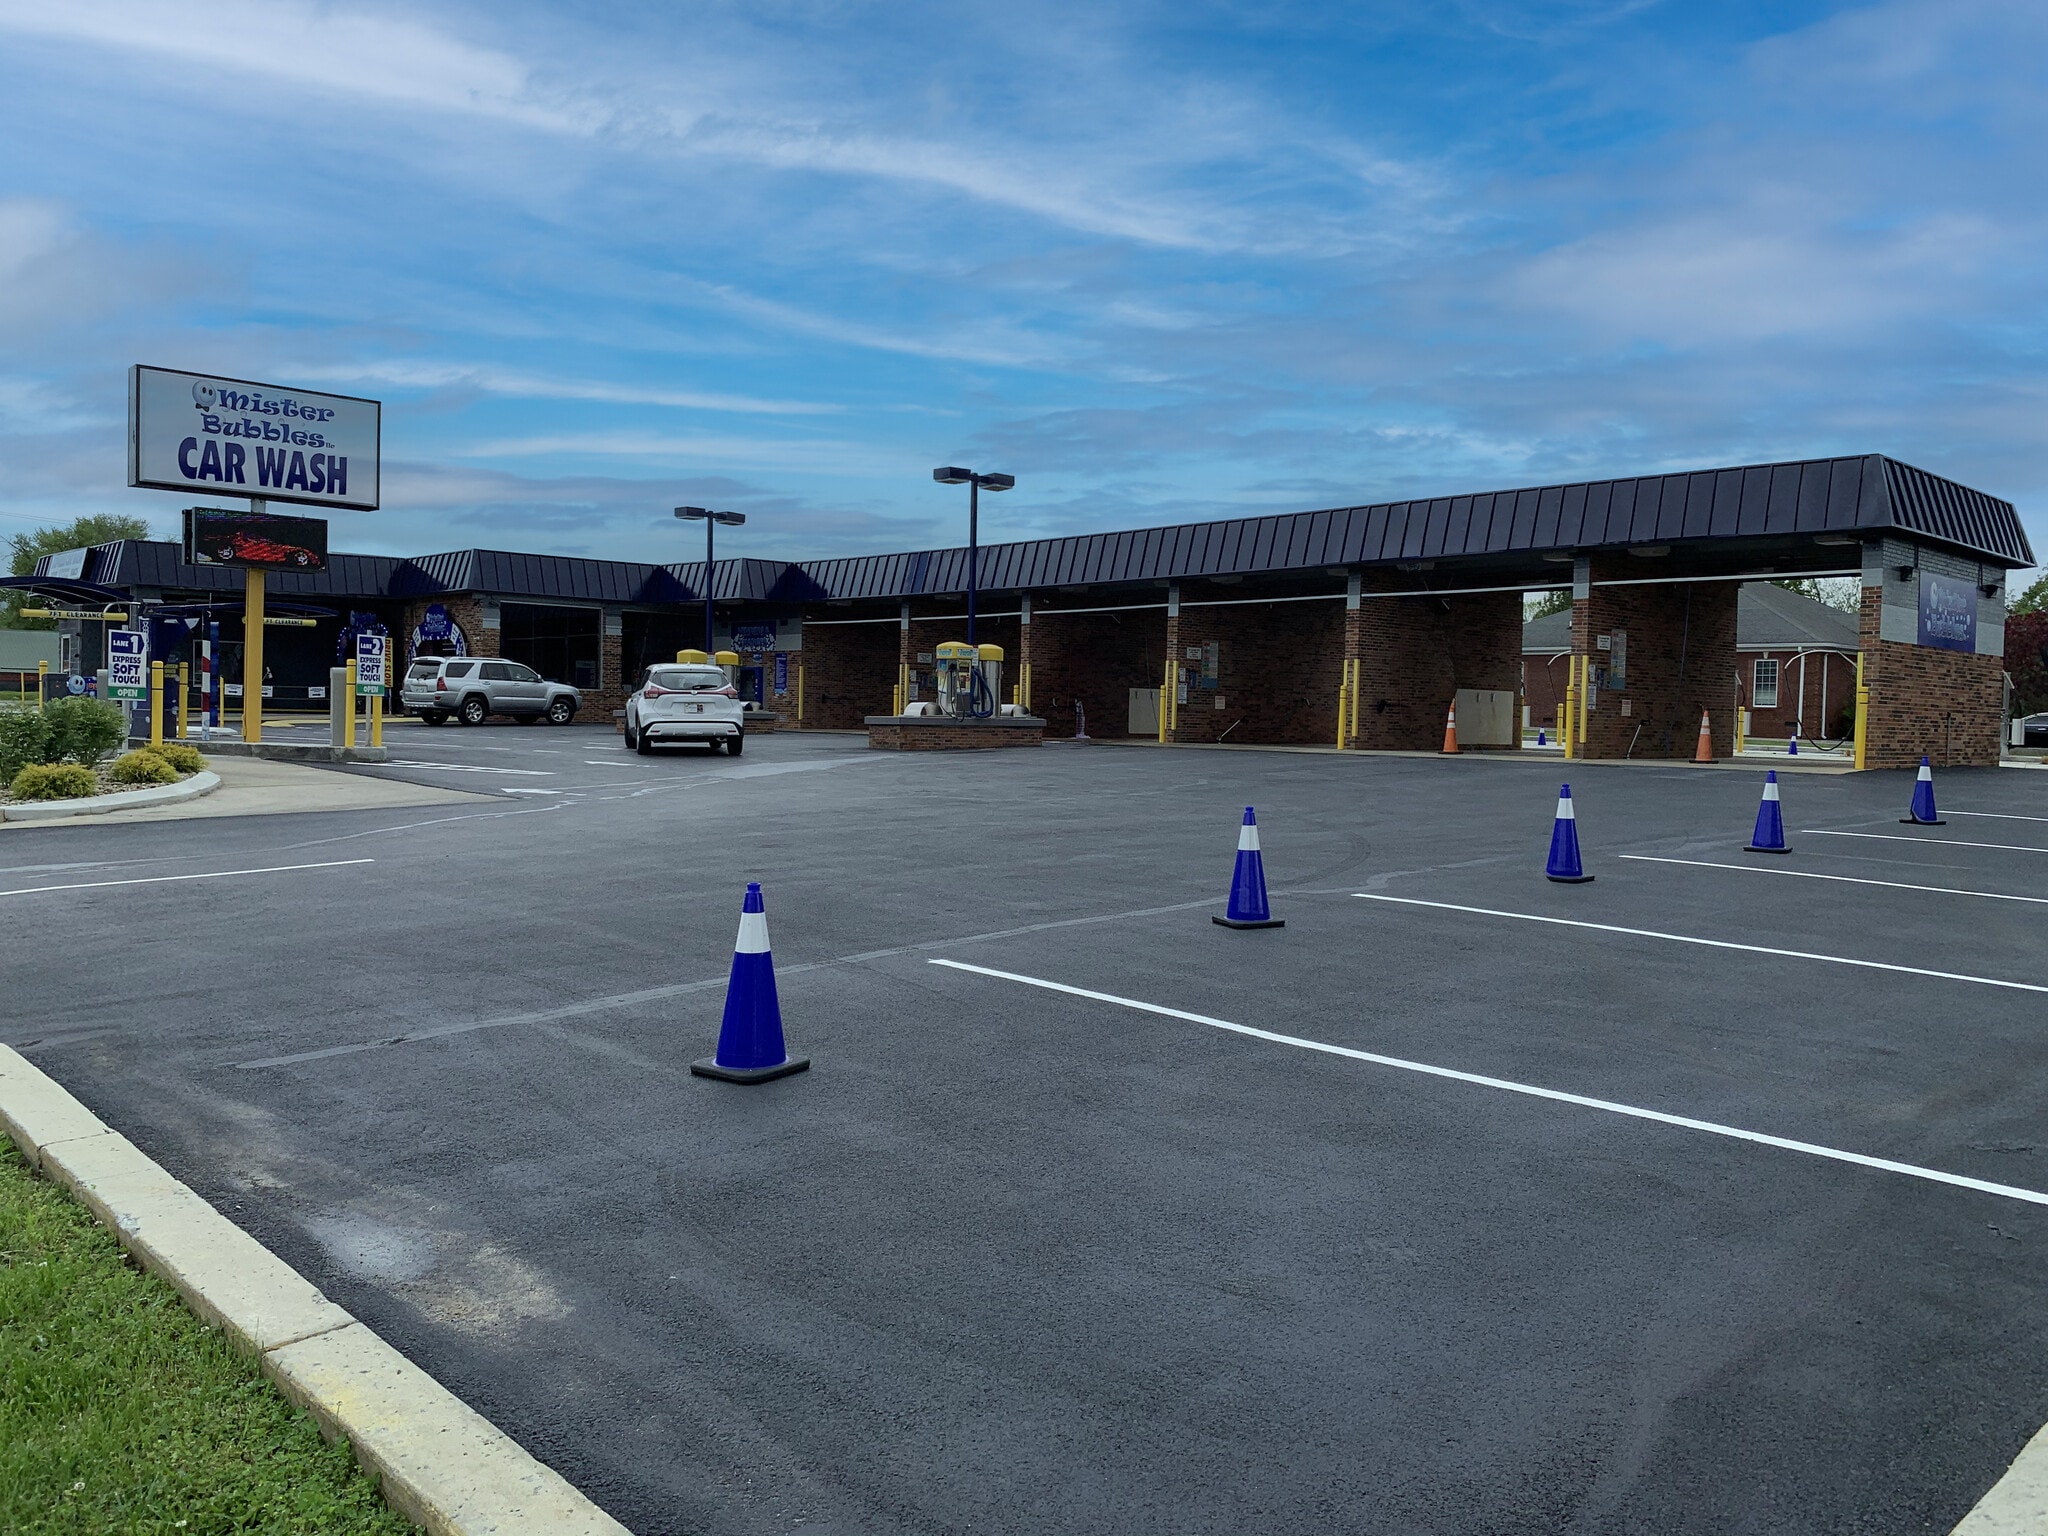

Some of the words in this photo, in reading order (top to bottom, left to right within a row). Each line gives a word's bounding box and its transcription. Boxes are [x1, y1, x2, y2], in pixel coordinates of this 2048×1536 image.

[217, 389, 335, 422] Mister
[201, 412, 326, 448] Bubbles
[178, 436, 246, 484] CAR
[256, 446, 348, 495] WASH
[130, 635, 139, 653] 1
[372, 638, 381, 654] 2
[113, 656, 141, 664] EXPRESS
[113, 663, 140, 675] SOFT
[360, 663, 380, 674] SOFT
[113, 675, 140, 684] TOUCH
[360, 673, 380, 682] TOUCH
[117, 689, 138, 697] OPEN
[363, 685, 379, 693] OPEN
